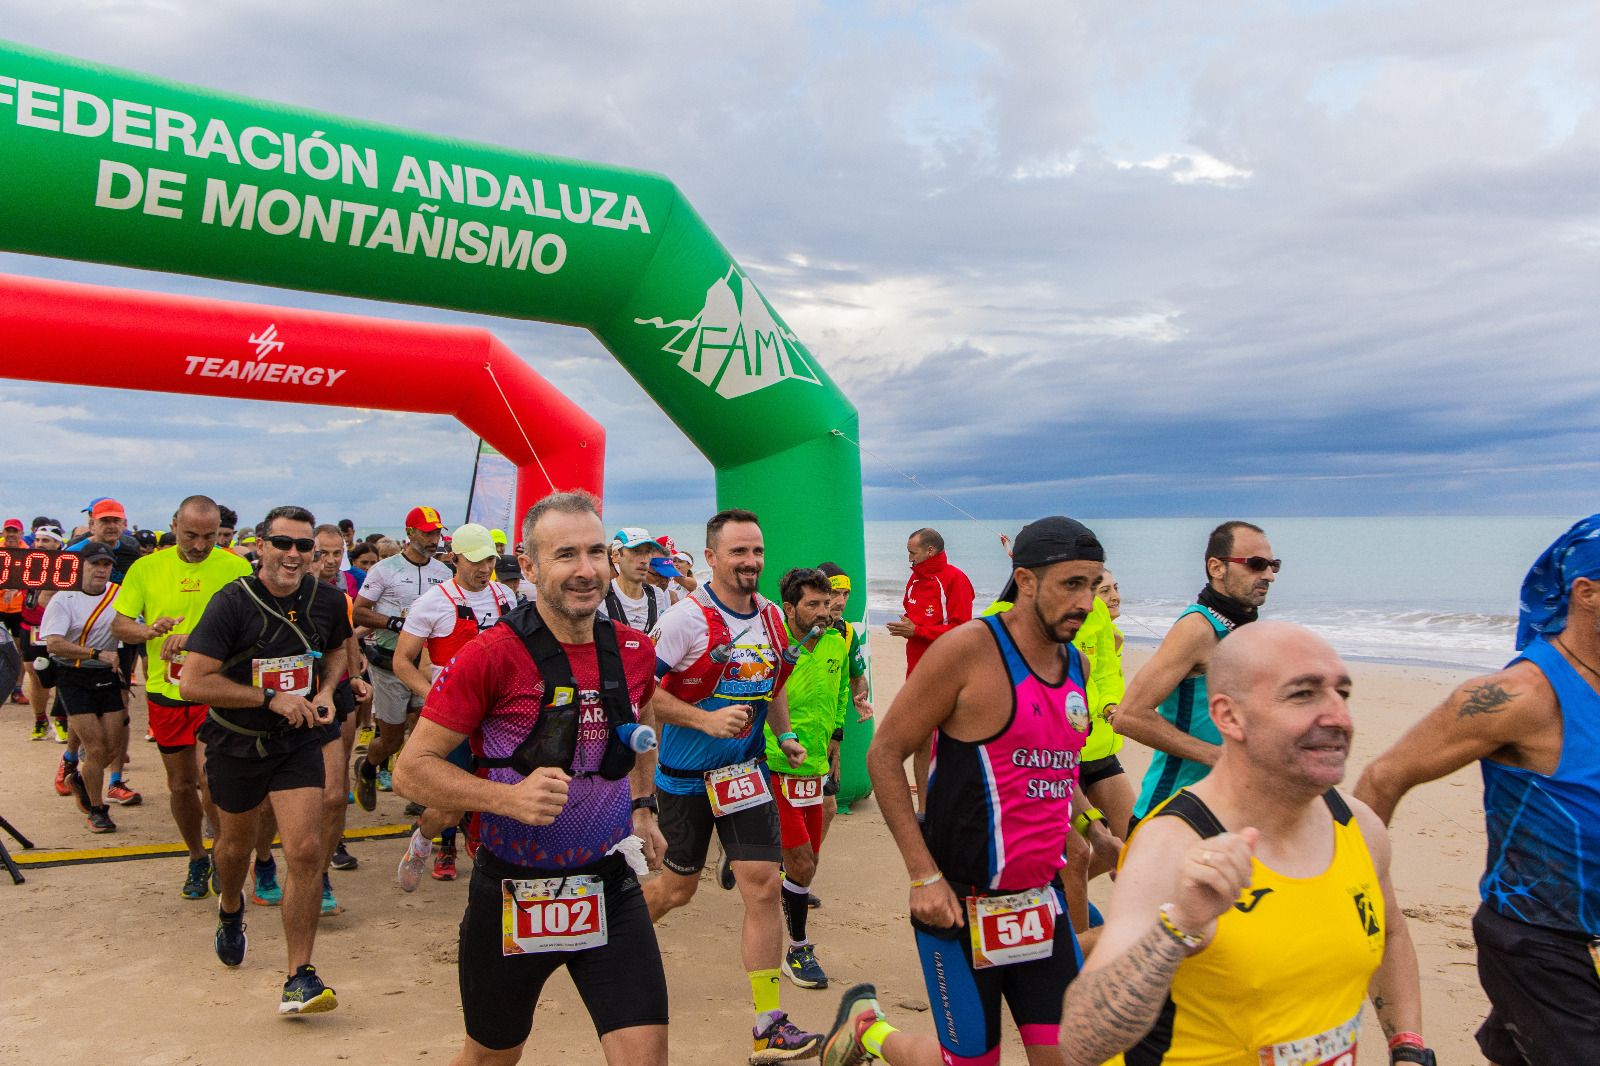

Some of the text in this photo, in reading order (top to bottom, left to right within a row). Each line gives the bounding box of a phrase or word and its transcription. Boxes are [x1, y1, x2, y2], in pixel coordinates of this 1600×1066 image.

[392, 155, 651, 234] ANDALUZA
[95, 159, 567, 275] DE MONTAÑISMO
[184, 355, 347, 387] TEAMERGY
[279, 672, 295, 690] 5
[727, 777, 755, 799] 45
[794, 781, 817, 797] 49
[525, 901, 592, 934] 102
[996, 911, 1045, 946] 54
